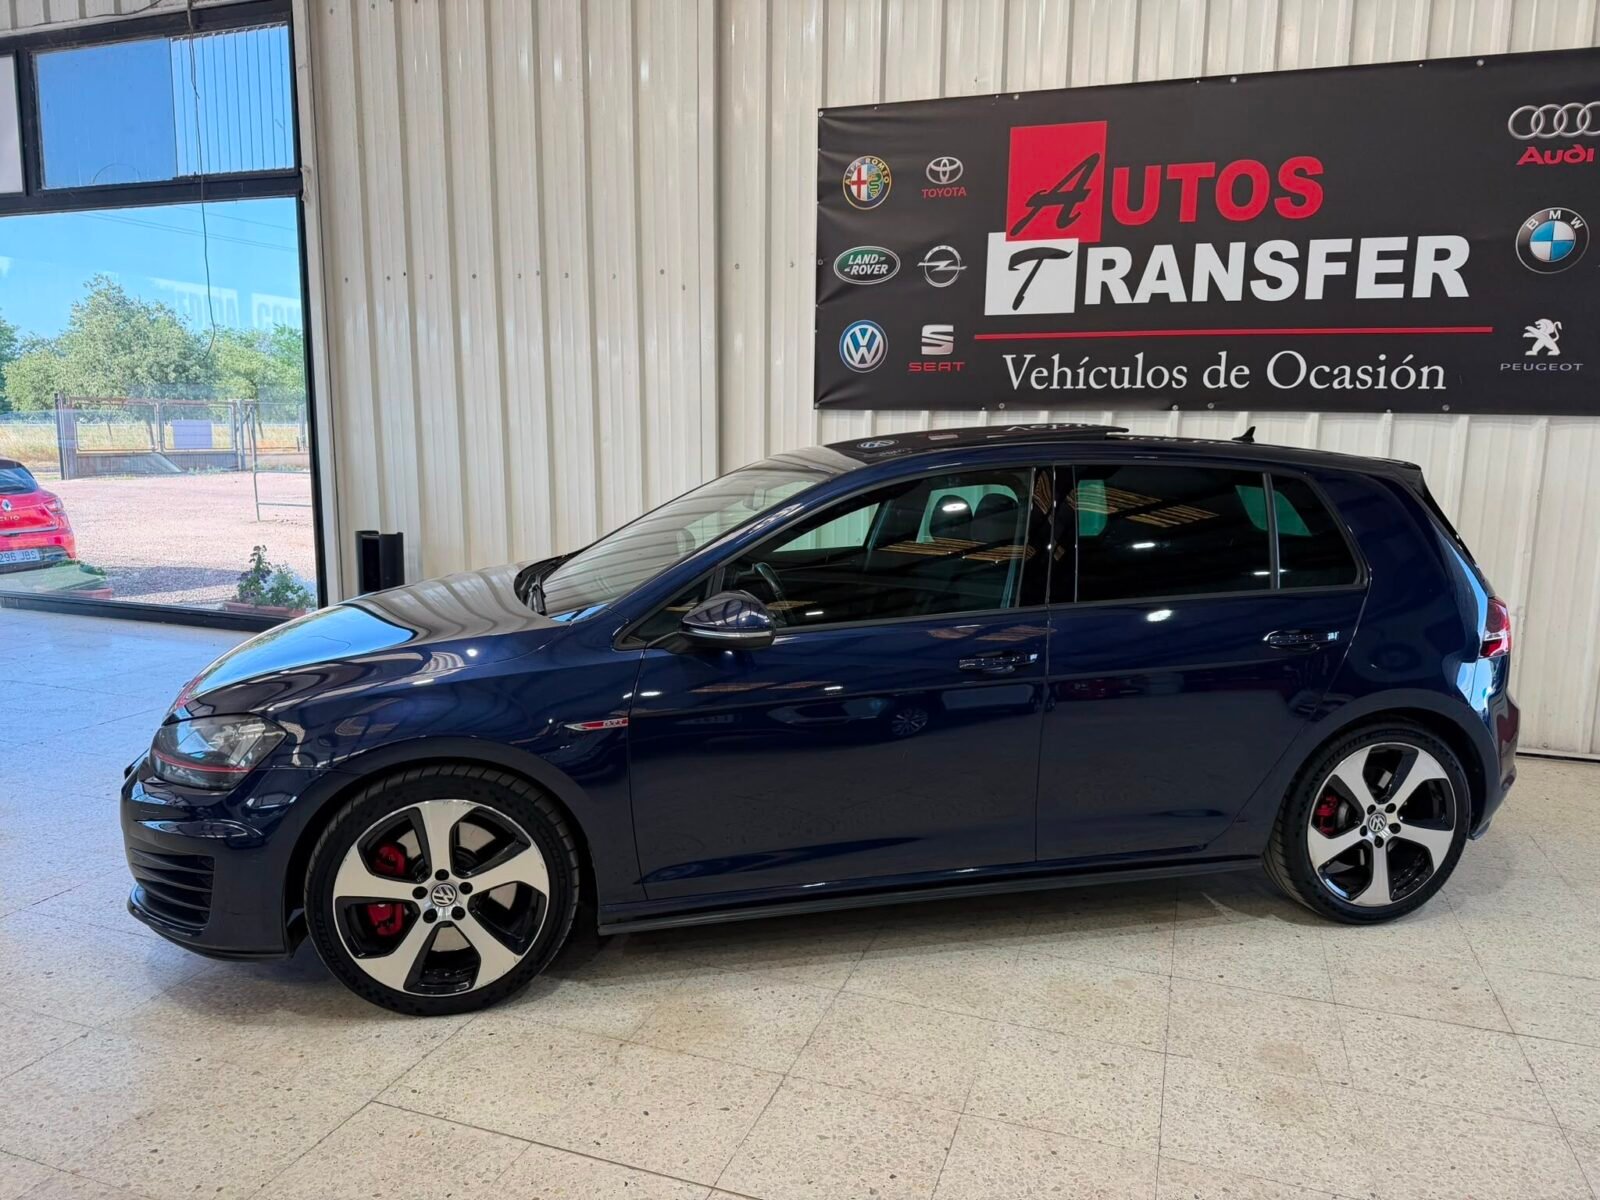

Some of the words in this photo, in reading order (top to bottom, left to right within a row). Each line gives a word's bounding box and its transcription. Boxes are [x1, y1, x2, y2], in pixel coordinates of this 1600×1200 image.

[1515, 144, 1595, 166] Audi
[865, 157, 890, 184] ROMEO
[921, 186, 967, 199] TOYOTA
[1526, 210, 1584, 231] BMW
[1007, 234, 1471, 312] TRANSFER
[908, 361, 966, 372] SEAT
[1002, 352, 1188, 391] Vehículos
[1202, 351, 1250, 389] de
[1266, 350, 1447, 390] Ocasión
[1500, 362, 1584, 372] PEUGEOT
